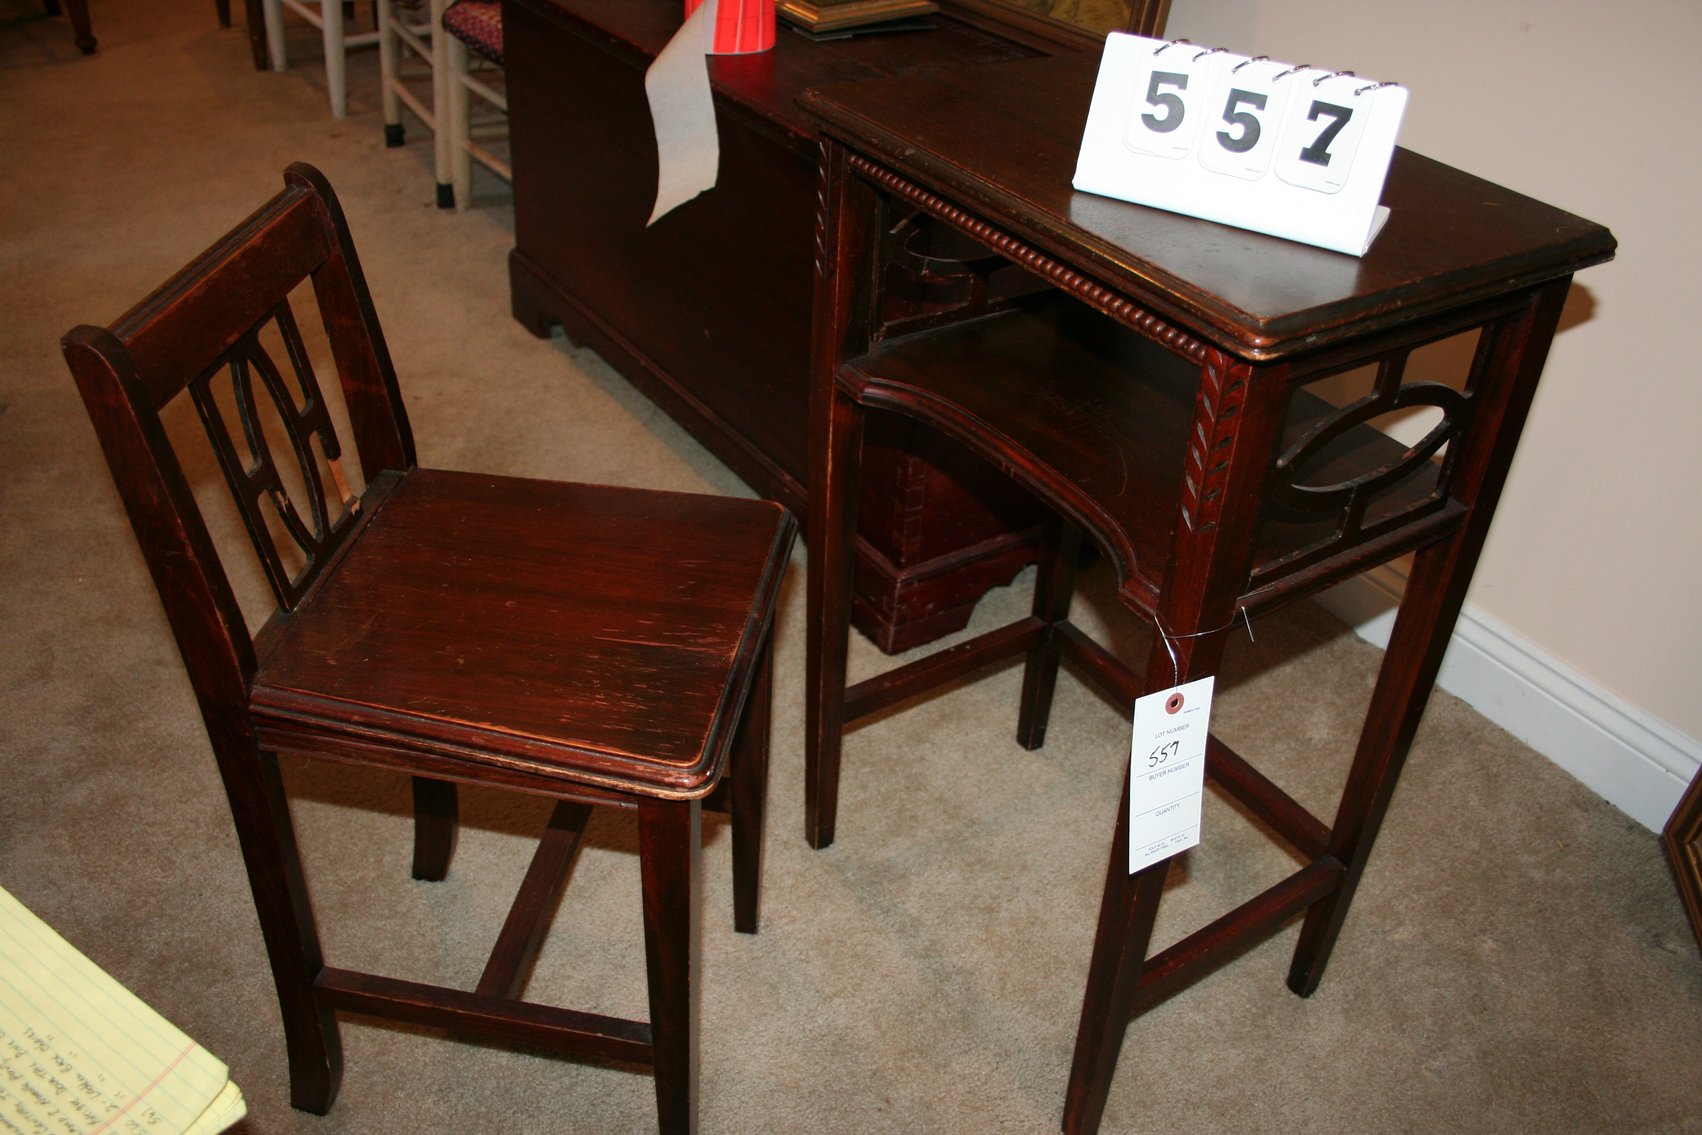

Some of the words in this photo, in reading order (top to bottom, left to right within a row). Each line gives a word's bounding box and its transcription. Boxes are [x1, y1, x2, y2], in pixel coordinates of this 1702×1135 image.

[1154, 731, 1166, 739] LOT
[1166, 723, 1190, 735] NUMBER
[1149, 740, 1180, 768] 557
[1148, 770, 1167, 781] BUYER
[1167, 762, 1190, 774] NUMBER
[1155, 803, 1181, 817] QUANTITY
